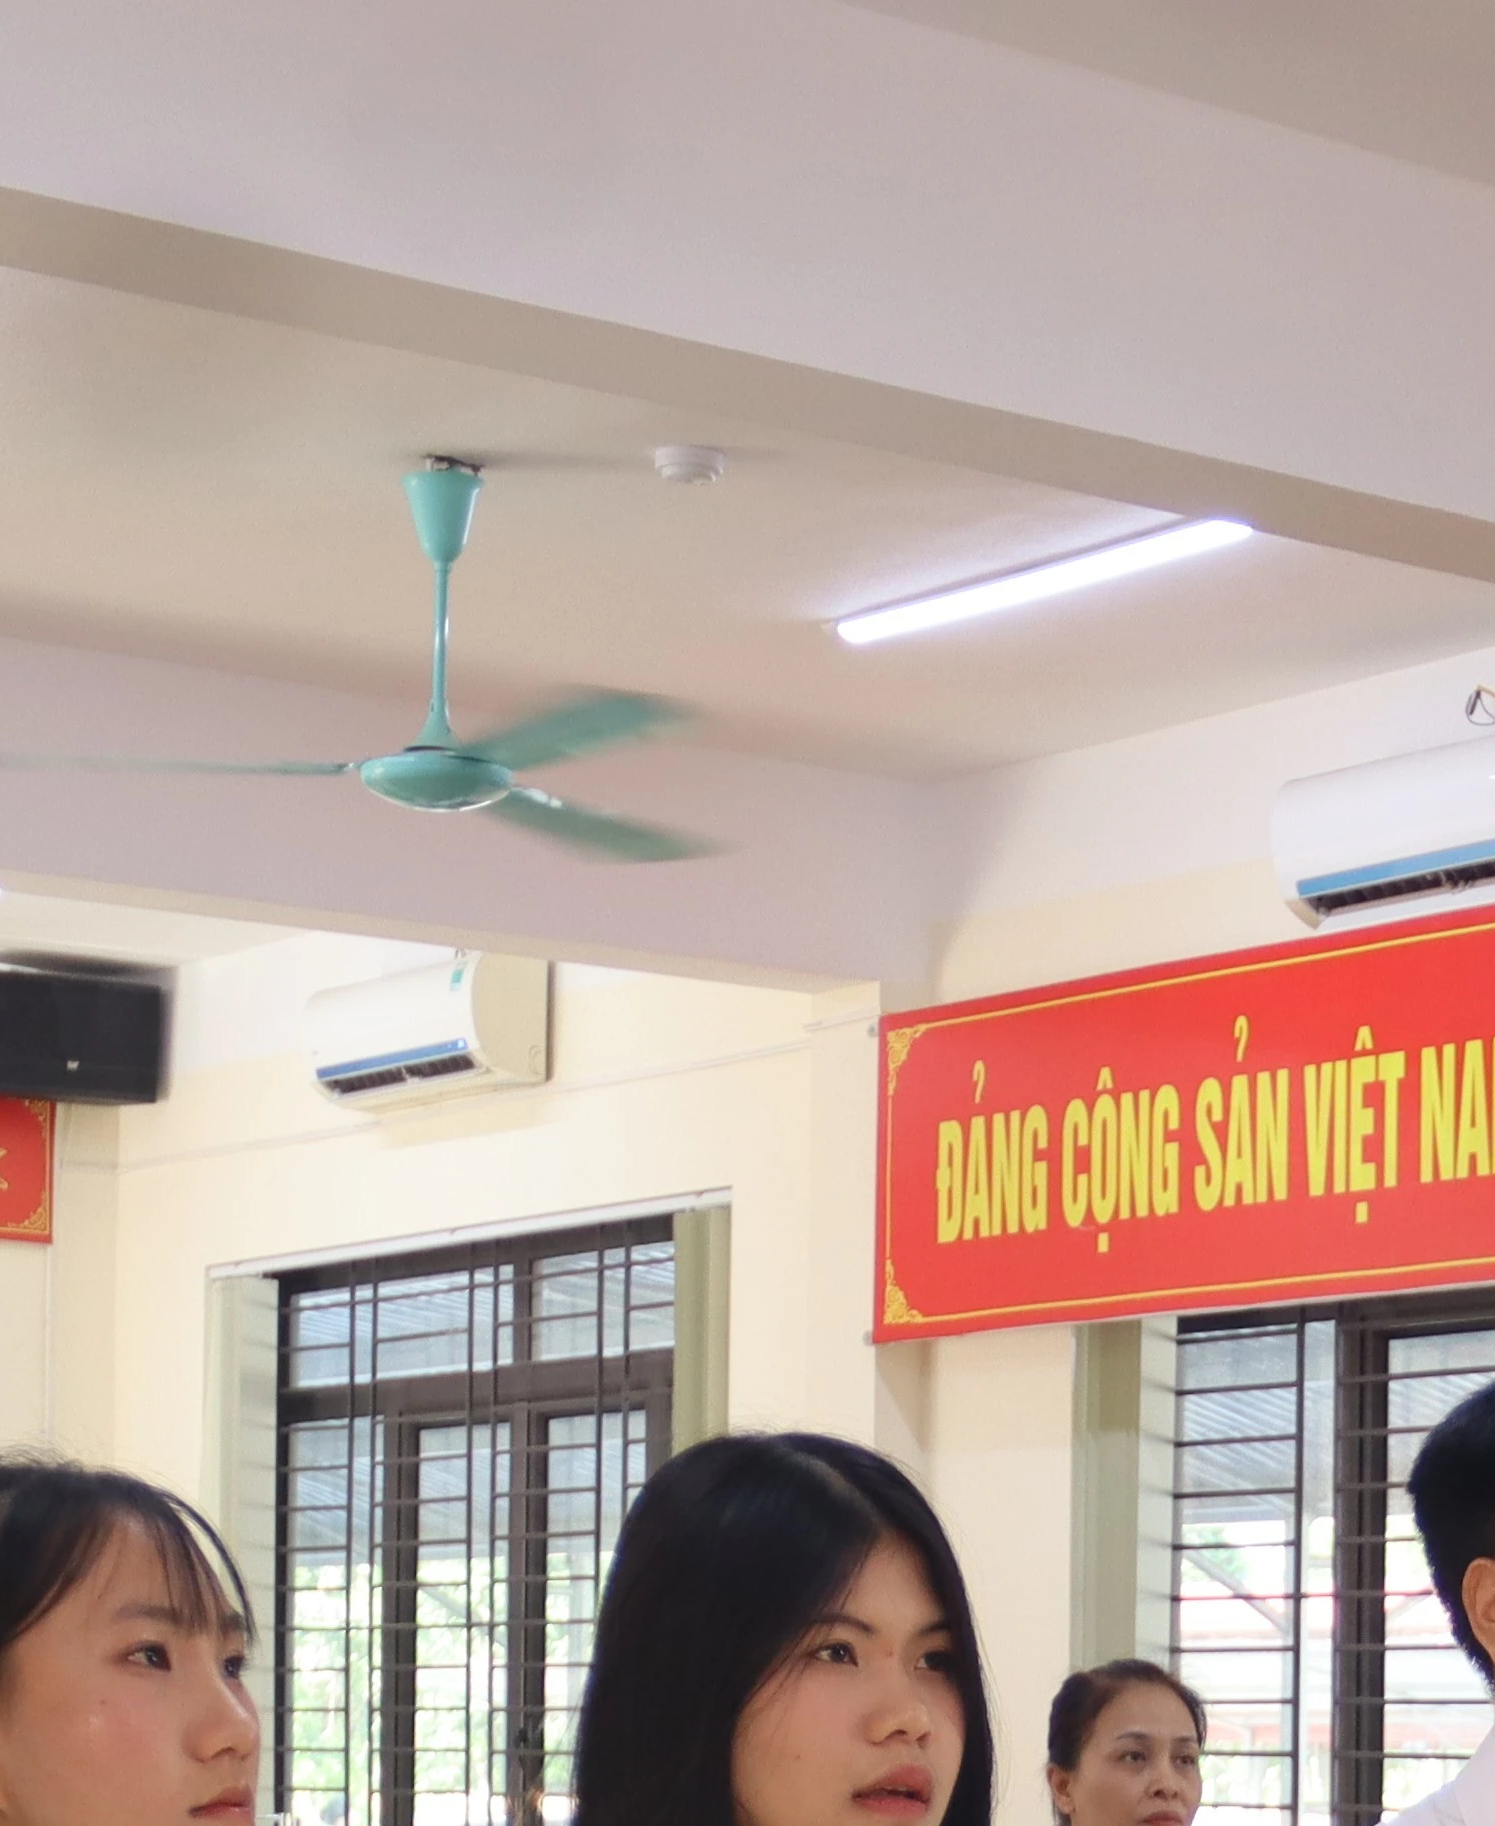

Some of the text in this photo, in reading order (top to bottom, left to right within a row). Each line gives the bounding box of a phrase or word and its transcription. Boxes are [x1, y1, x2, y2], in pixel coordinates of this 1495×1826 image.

[936, 1060, 1049, 1244] ĐẢNG
[1061, 1066, 1180, 1253] CỘNG
[1194, 1015, 1290, 1211] SẢN
[1303, 1025, 1406, 1224] VIỆT
